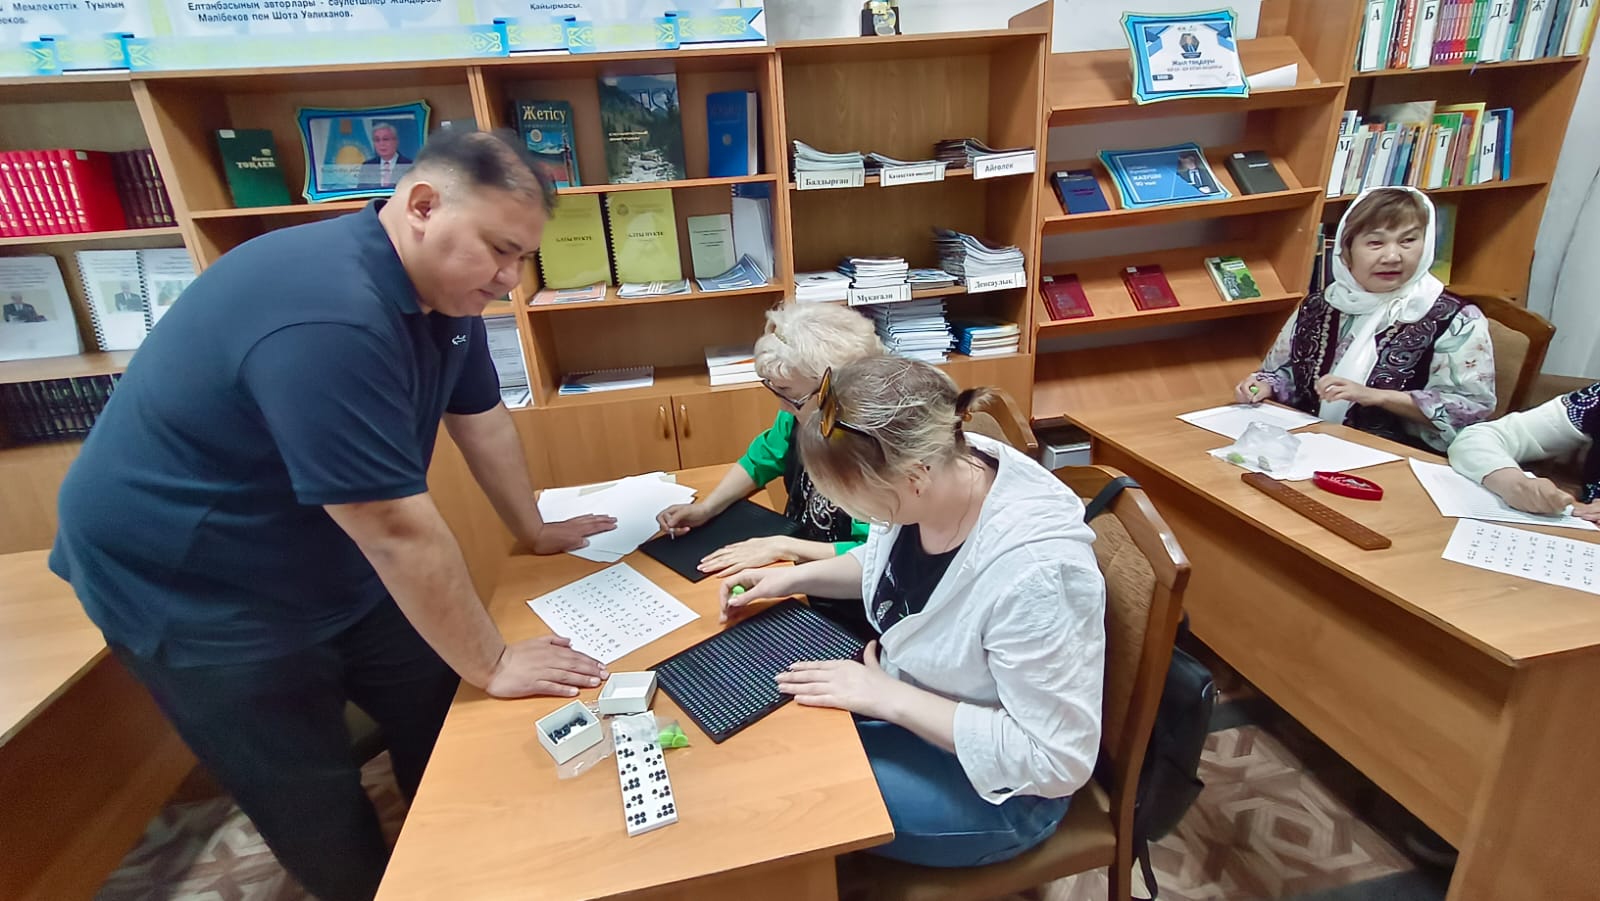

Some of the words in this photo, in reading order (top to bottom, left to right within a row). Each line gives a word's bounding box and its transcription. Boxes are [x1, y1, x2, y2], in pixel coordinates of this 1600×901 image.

[264, 0, 316, 9] авторлары
[1490, 3, 1503, 19] Д
[273, 11, 298, 20] Шота
[1371, 8, 1380, 20] А
[1425, 5, 1435, 20] Б
[522, 105, 567, 123] Жетісу
[1338, 140, 1350, 151] М
[1382, 137, 1392, 150] С
[1440, 134, 1449, 148] Т
